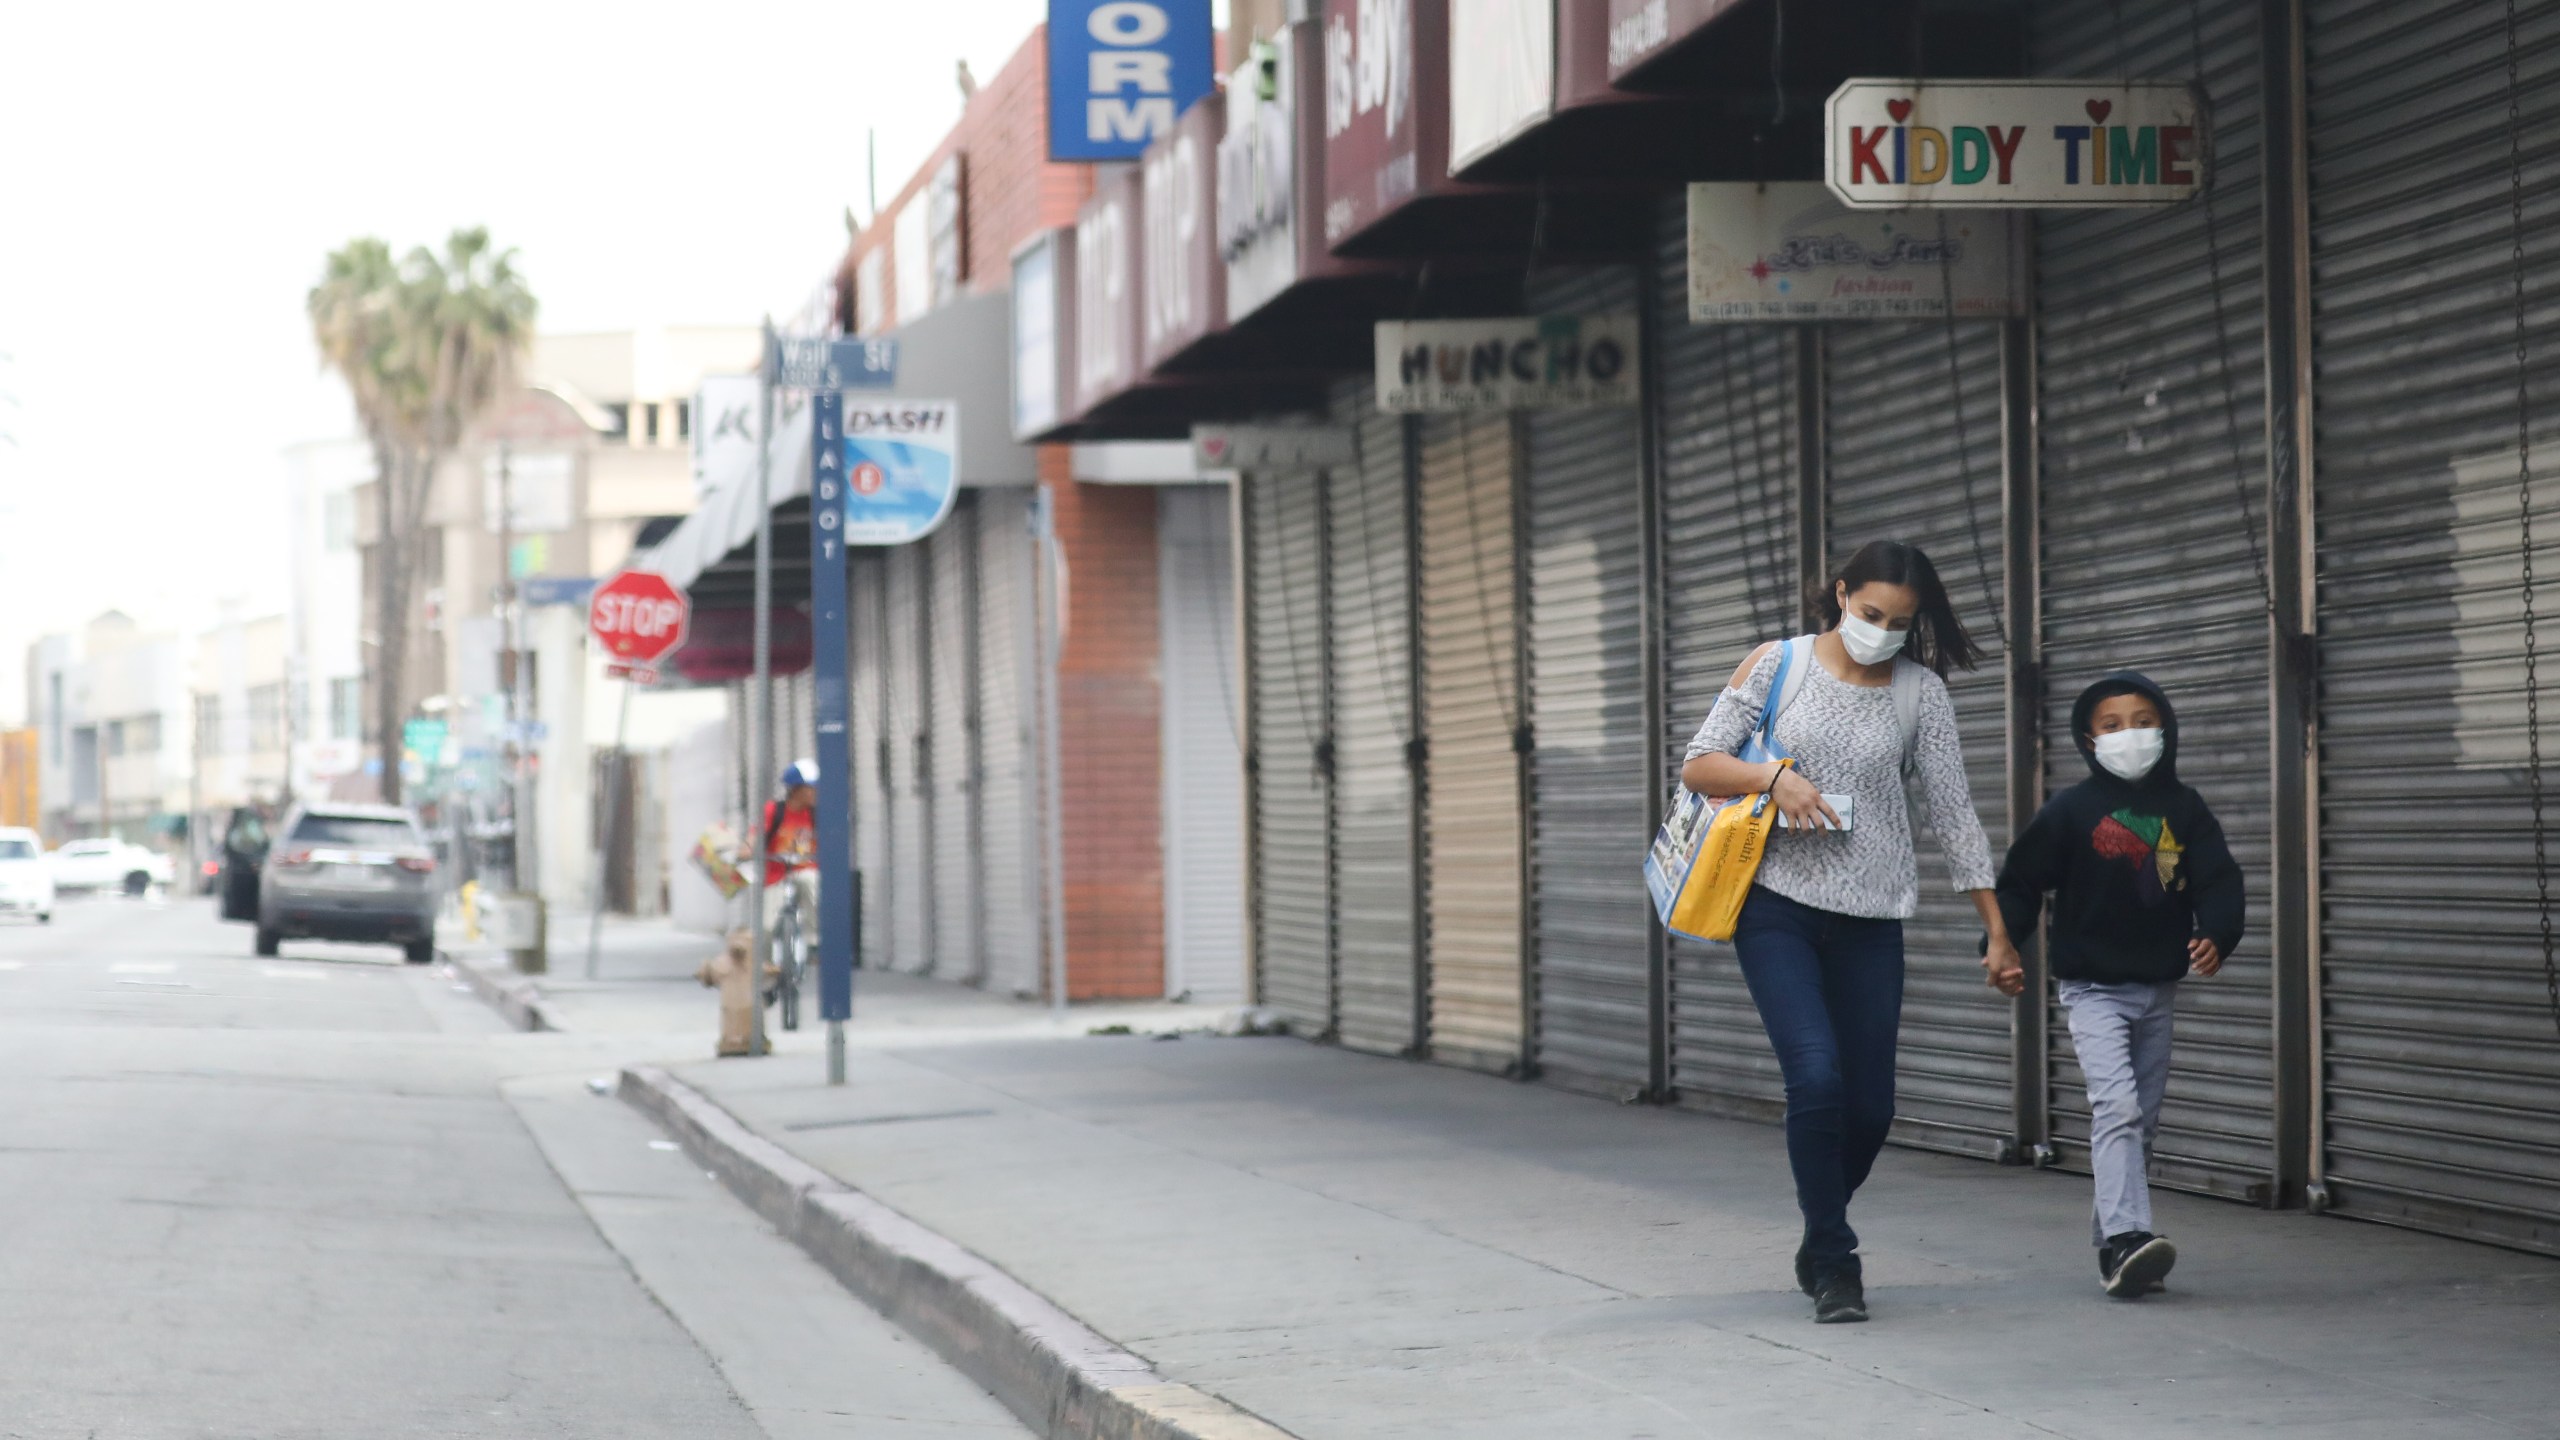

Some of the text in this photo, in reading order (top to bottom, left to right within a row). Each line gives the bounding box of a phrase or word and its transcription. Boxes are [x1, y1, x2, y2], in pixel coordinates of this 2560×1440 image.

[1850, 125, 2195, 185] KIDDY TIME
[1400, 334, 1625, 386] HUNCHO
[850, 410, 945, 434] DASH
[593, 594, 679, 638] STOP
[1739, 793, 1771, 865] CLA Health
